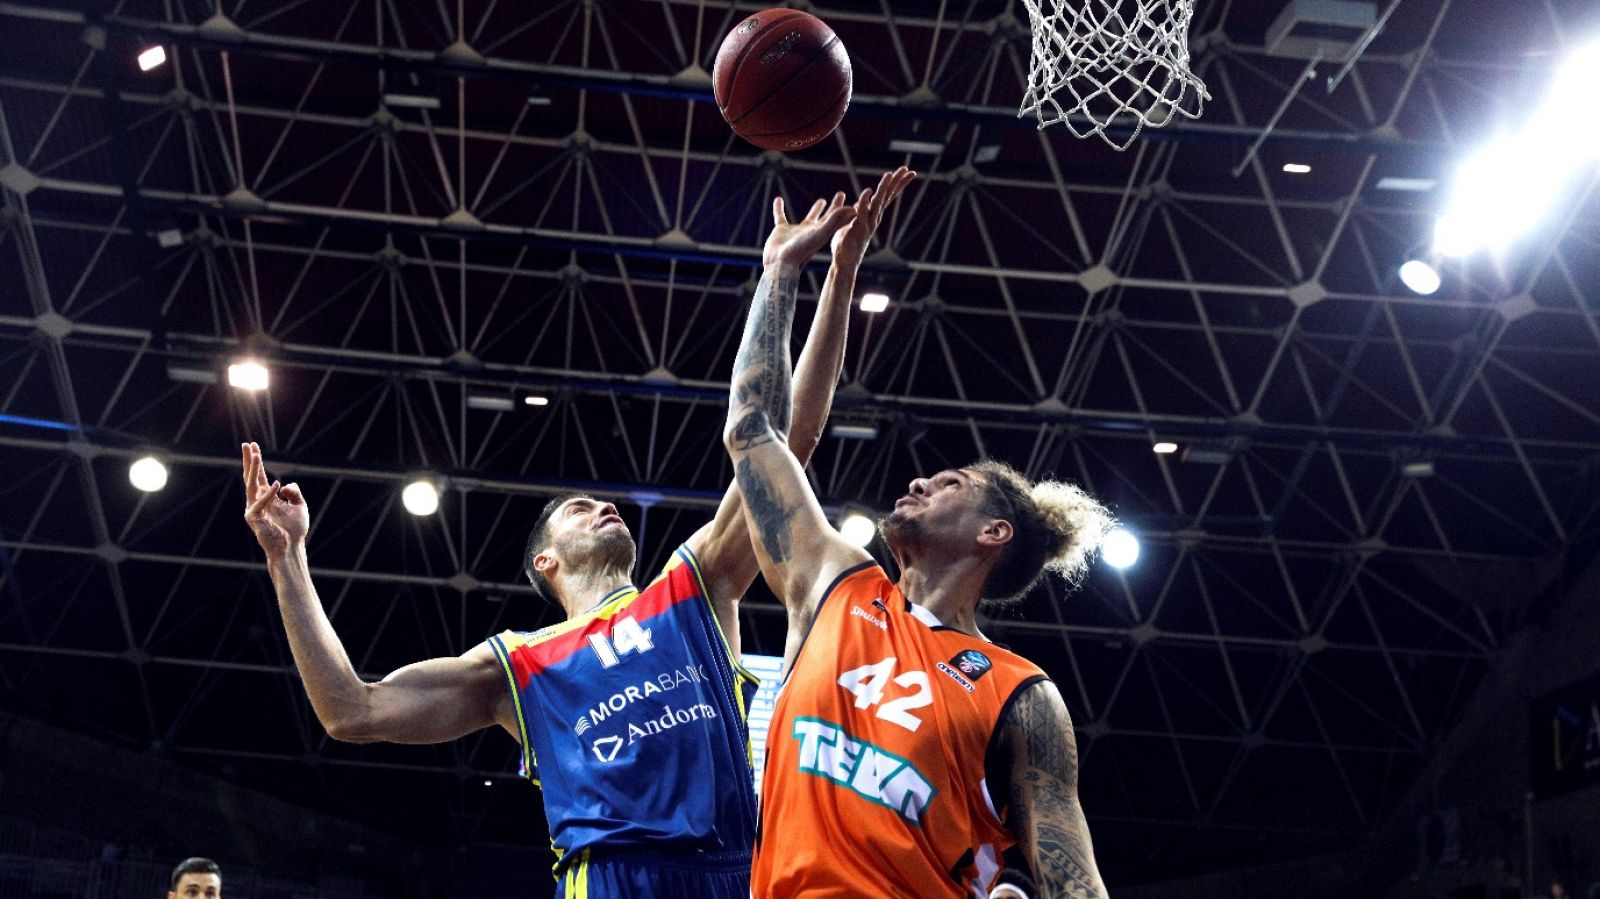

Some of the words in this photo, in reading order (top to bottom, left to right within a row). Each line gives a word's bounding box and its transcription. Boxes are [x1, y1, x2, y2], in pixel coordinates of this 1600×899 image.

[586, 615, 655, 670] 14
[837, 657, 933, 733] 42
[794, 719, 935, 824] TEVA
